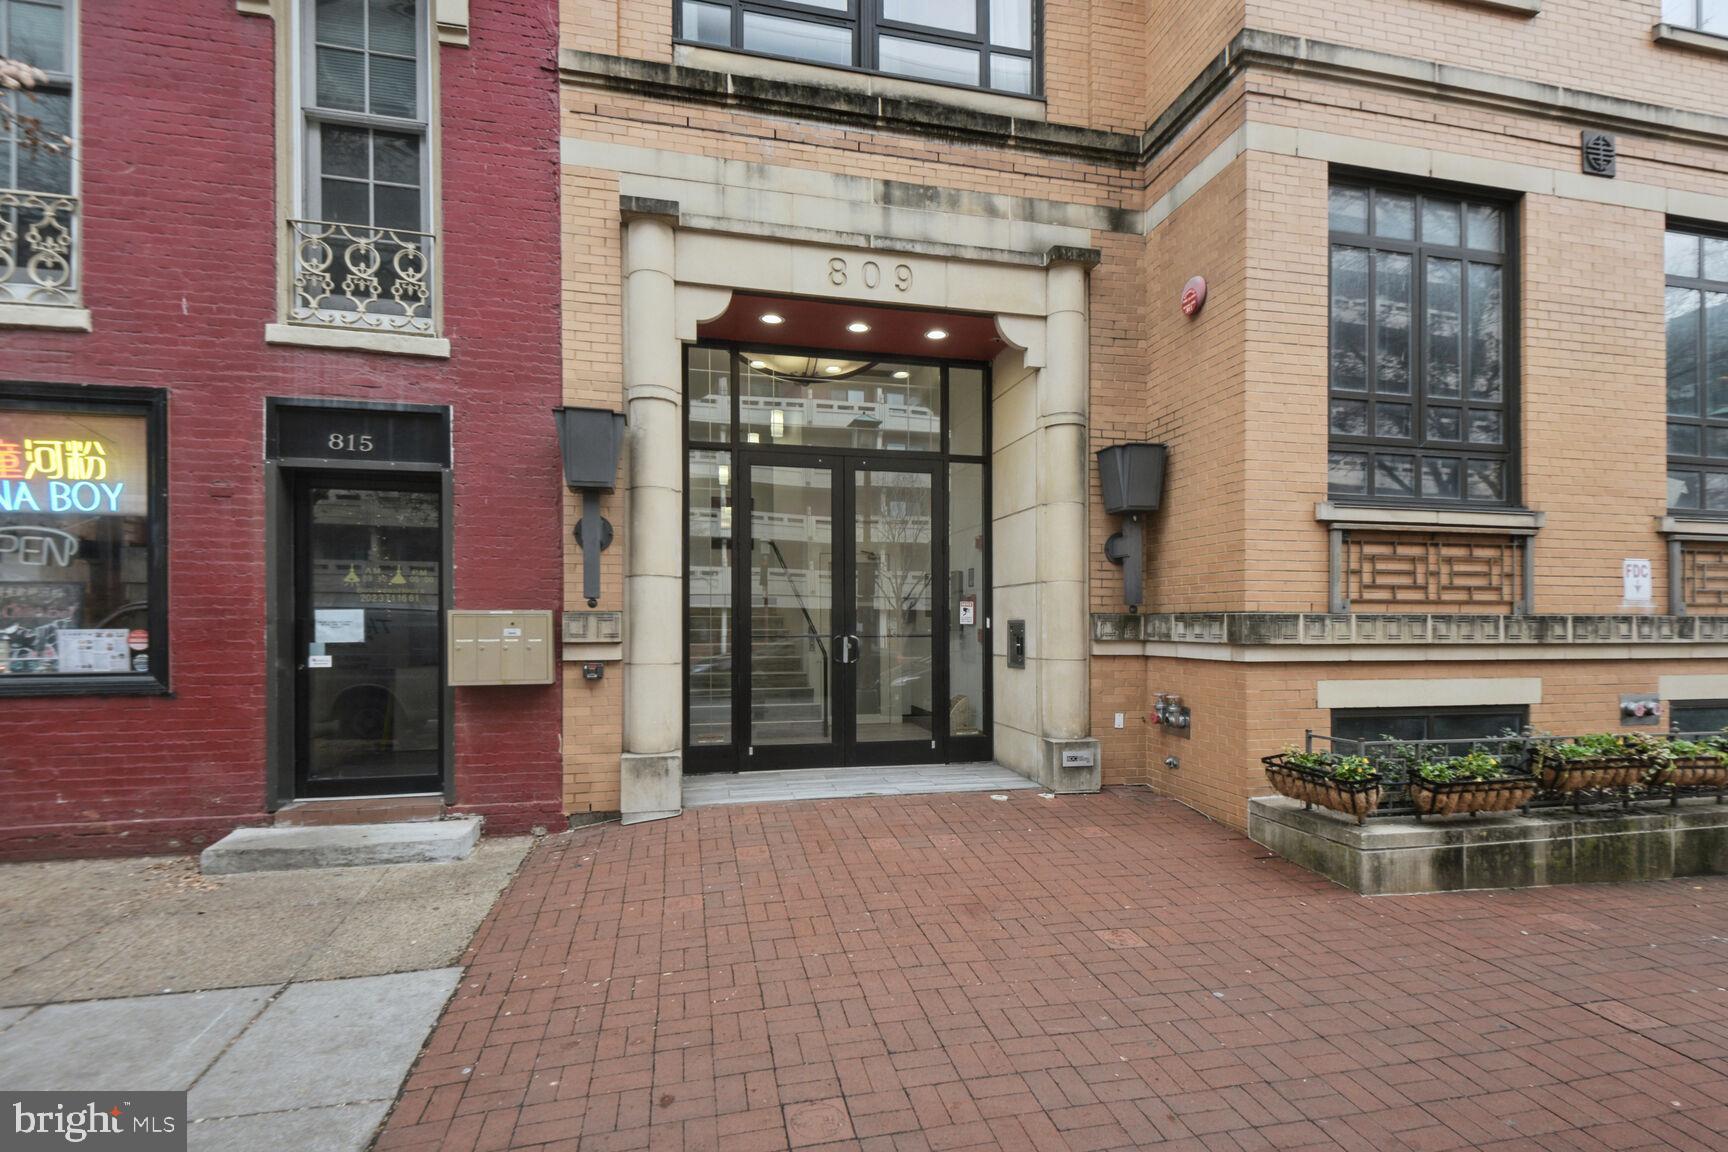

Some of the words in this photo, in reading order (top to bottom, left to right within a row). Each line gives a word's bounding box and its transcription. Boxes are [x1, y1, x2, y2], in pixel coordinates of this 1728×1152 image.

[828, 257, 913, 292] 809
[328, 433, 373, 452] 815
[49, 481, 123, 512] BOY
[1626, 564, 1649, 578] FDC
